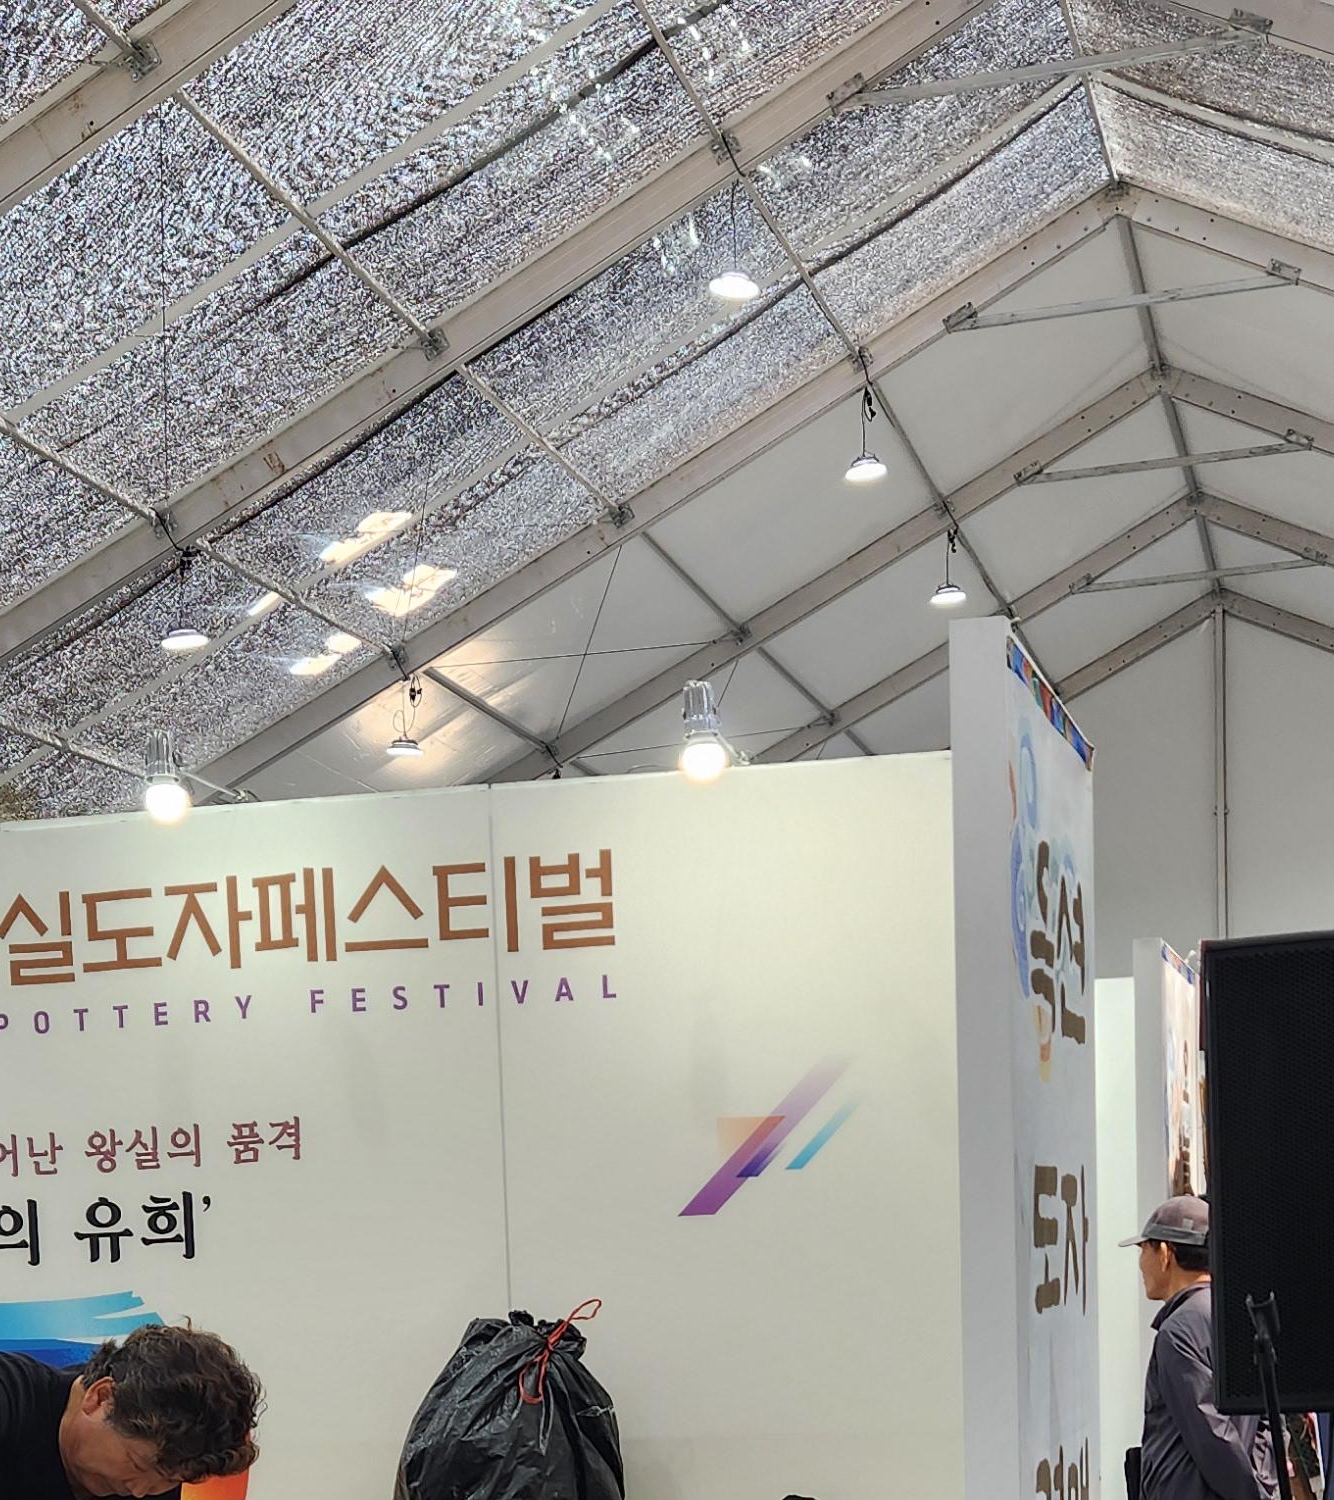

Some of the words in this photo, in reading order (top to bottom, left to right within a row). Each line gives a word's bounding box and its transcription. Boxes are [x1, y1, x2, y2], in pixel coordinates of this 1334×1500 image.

[309, 974, 618, 1014] FESTIVAL
[84, 1123, 203, 1174] 왕실의
[226, 1116, 303, 1165] 품격
[1033, 1163, 1089, 1317] 도자
